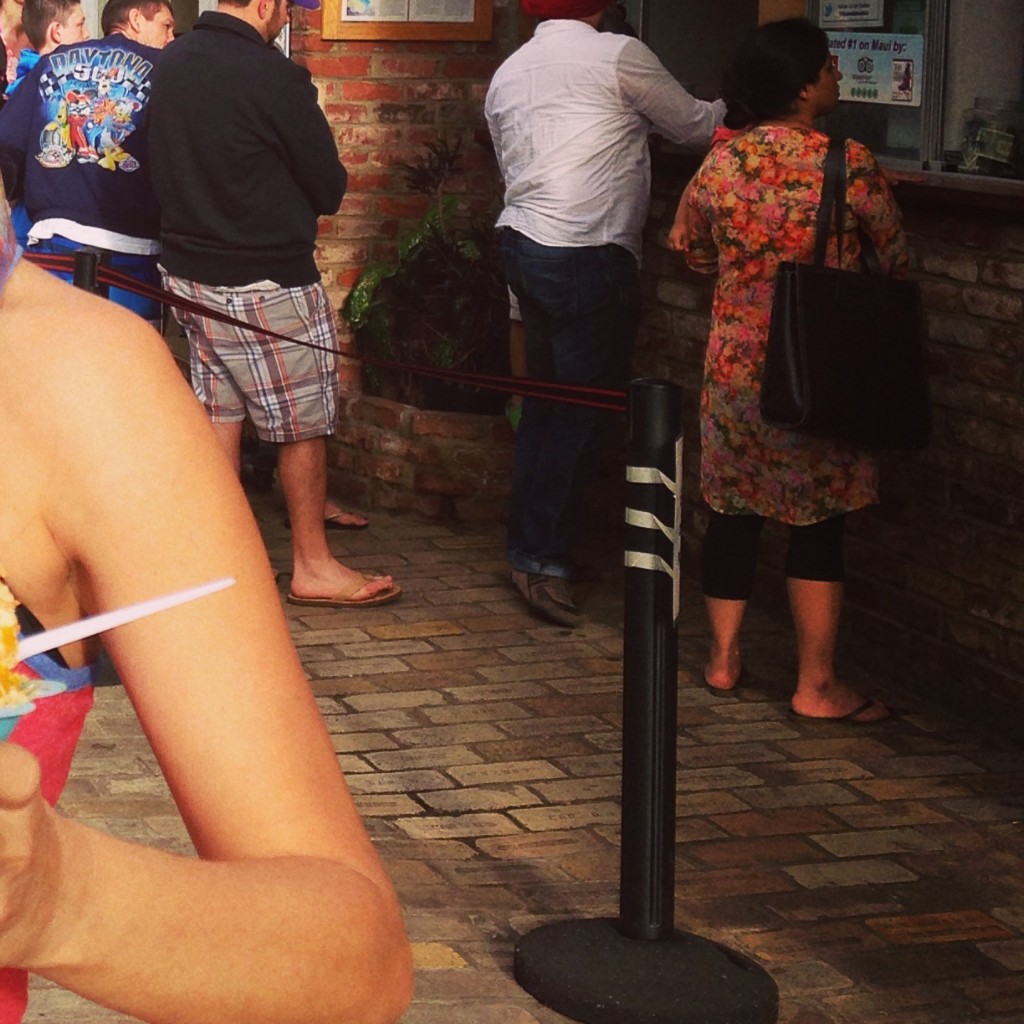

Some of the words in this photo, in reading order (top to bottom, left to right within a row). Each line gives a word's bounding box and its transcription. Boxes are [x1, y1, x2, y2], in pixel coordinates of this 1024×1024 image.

[828, 38, 846, 50] ated
[847, 38, 857, 50] #1
[858, 40, 870, 51] on
[871, 39, 892, 52] Maui
[49, 47, 153, 86] DAYTONA
[74, 63, 125, 83] 500
